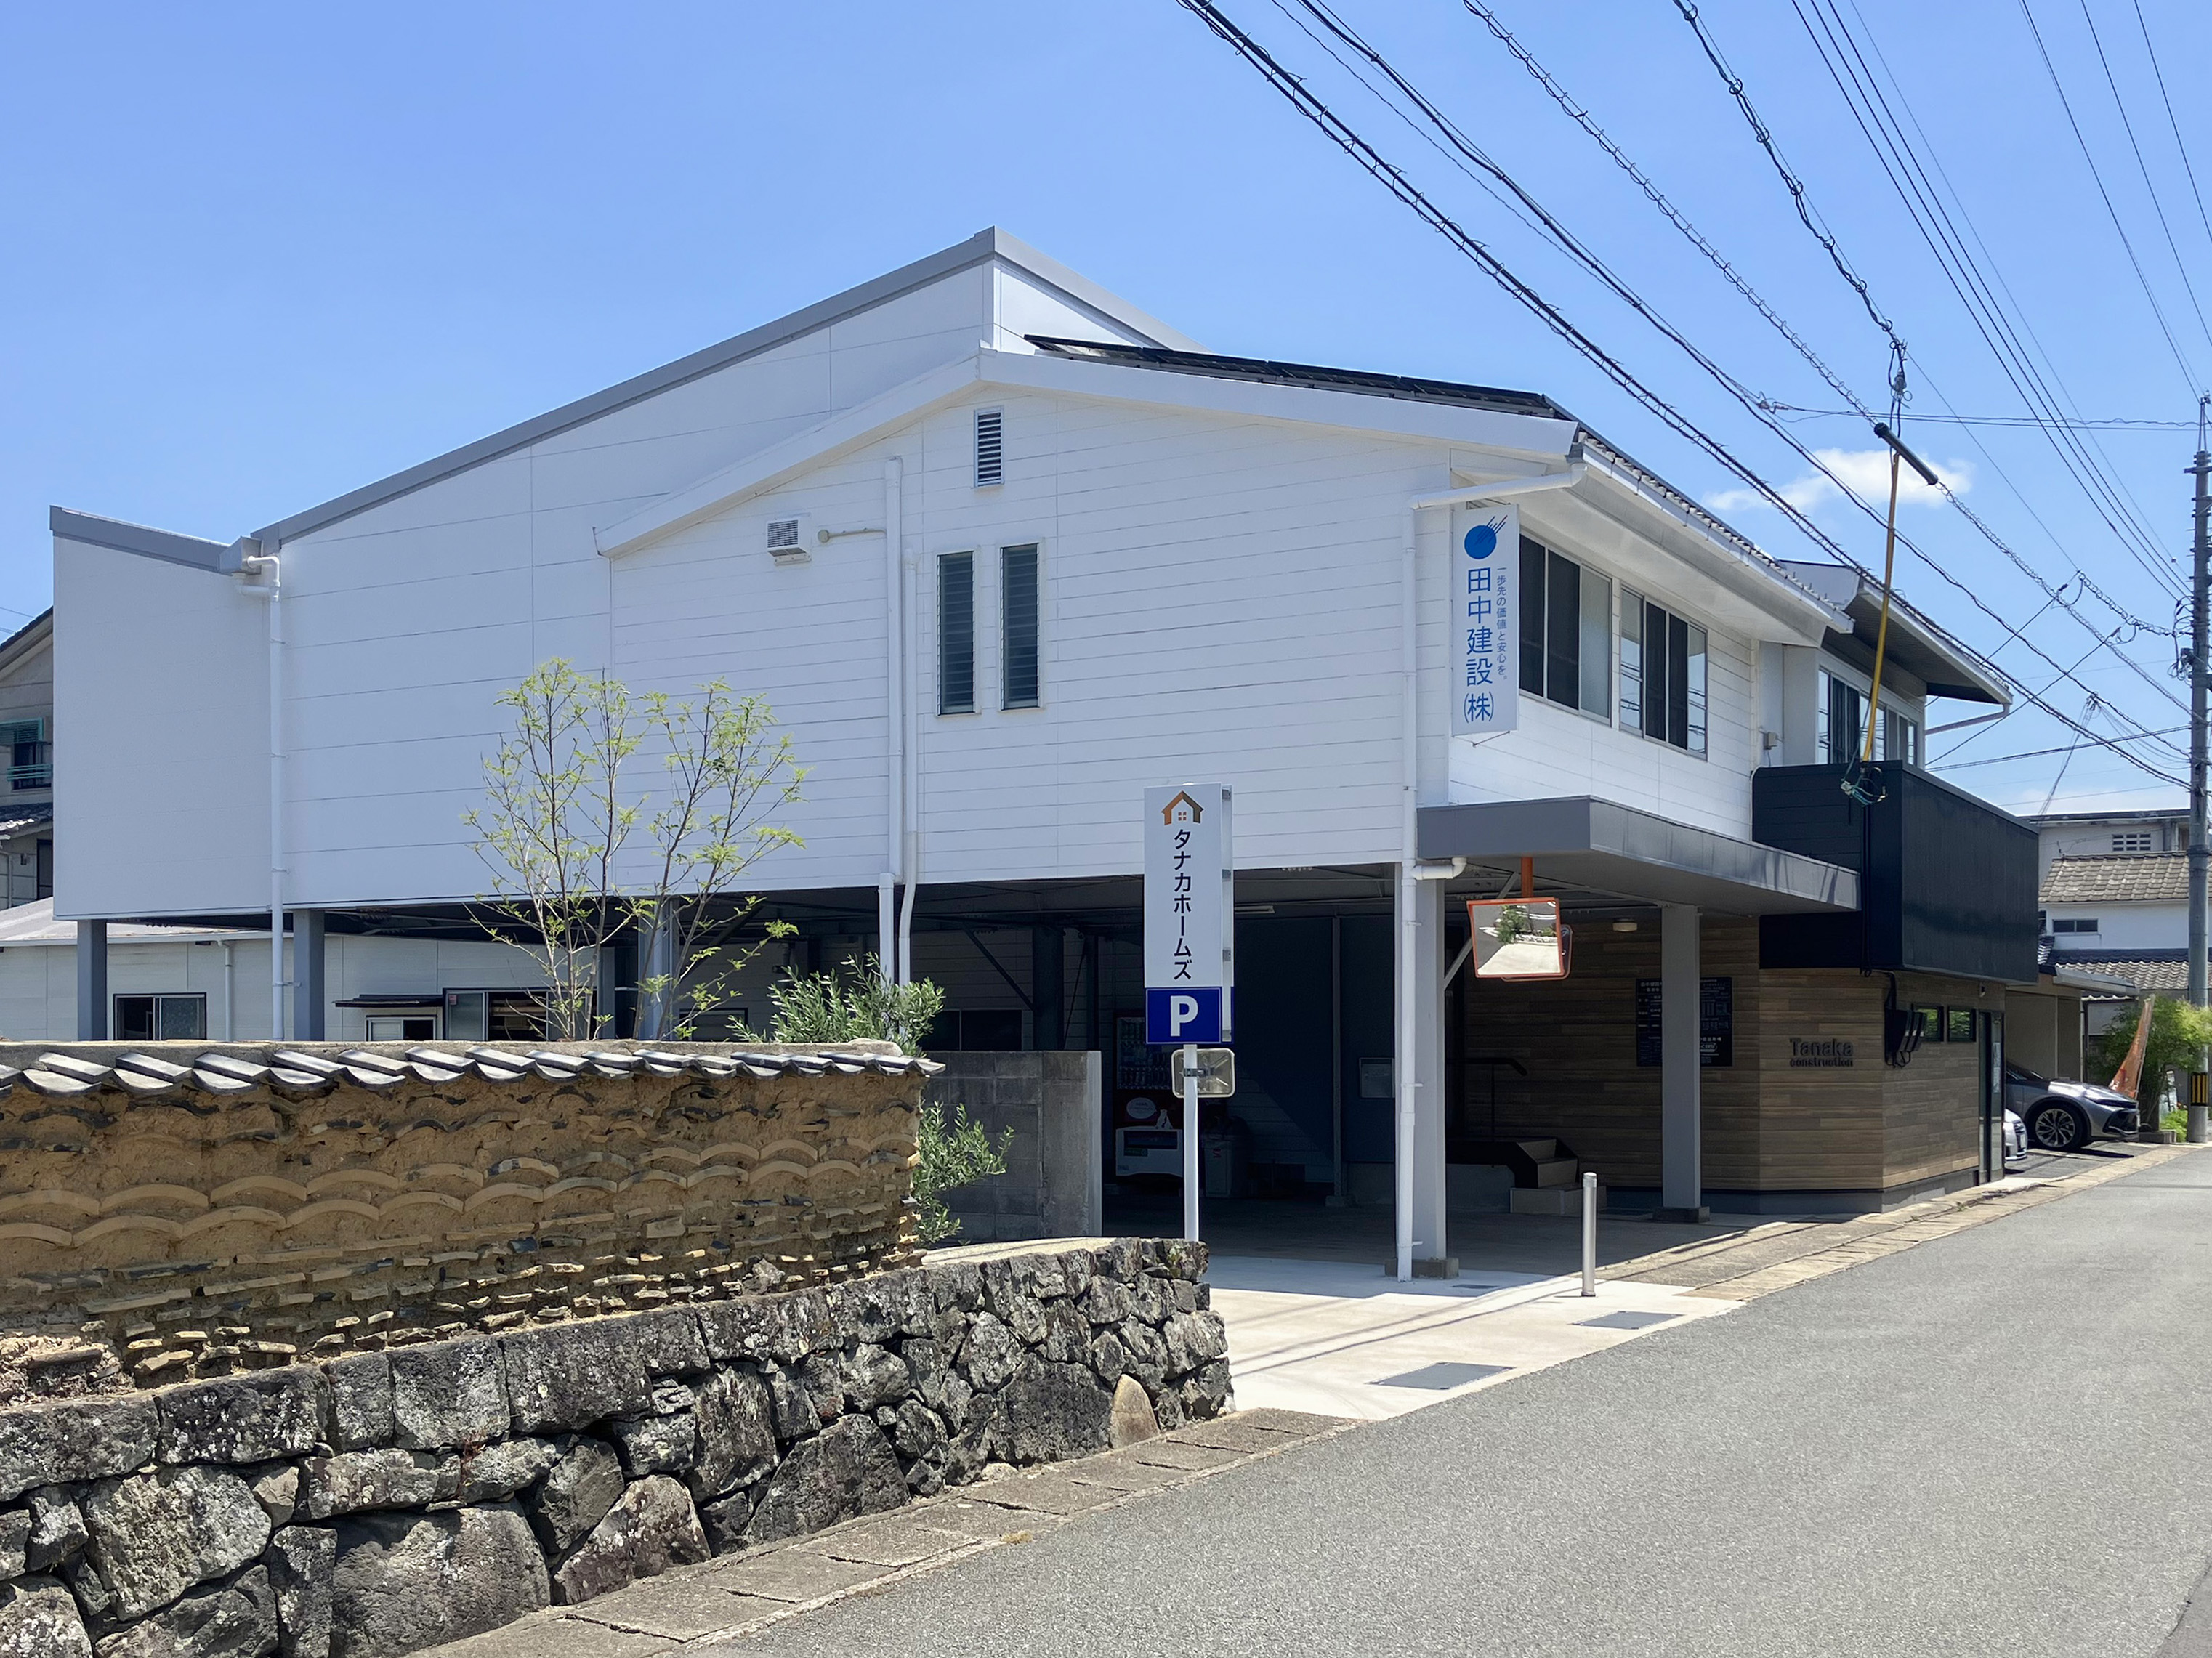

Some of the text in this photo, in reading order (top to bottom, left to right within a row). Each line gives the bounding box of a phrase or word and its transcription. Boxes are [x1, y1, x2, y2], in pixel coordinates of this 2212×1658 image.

[1496, 567, 1508, 680] 一歩先の価値と安心を。
[1173, 829, 1192, 980] タナカホームズ
[1170, 995, 1198, 1037] P
[1789, 1037, 1854, 1056] Tanaka
[1789, 1056, 1854, 1067] construction
